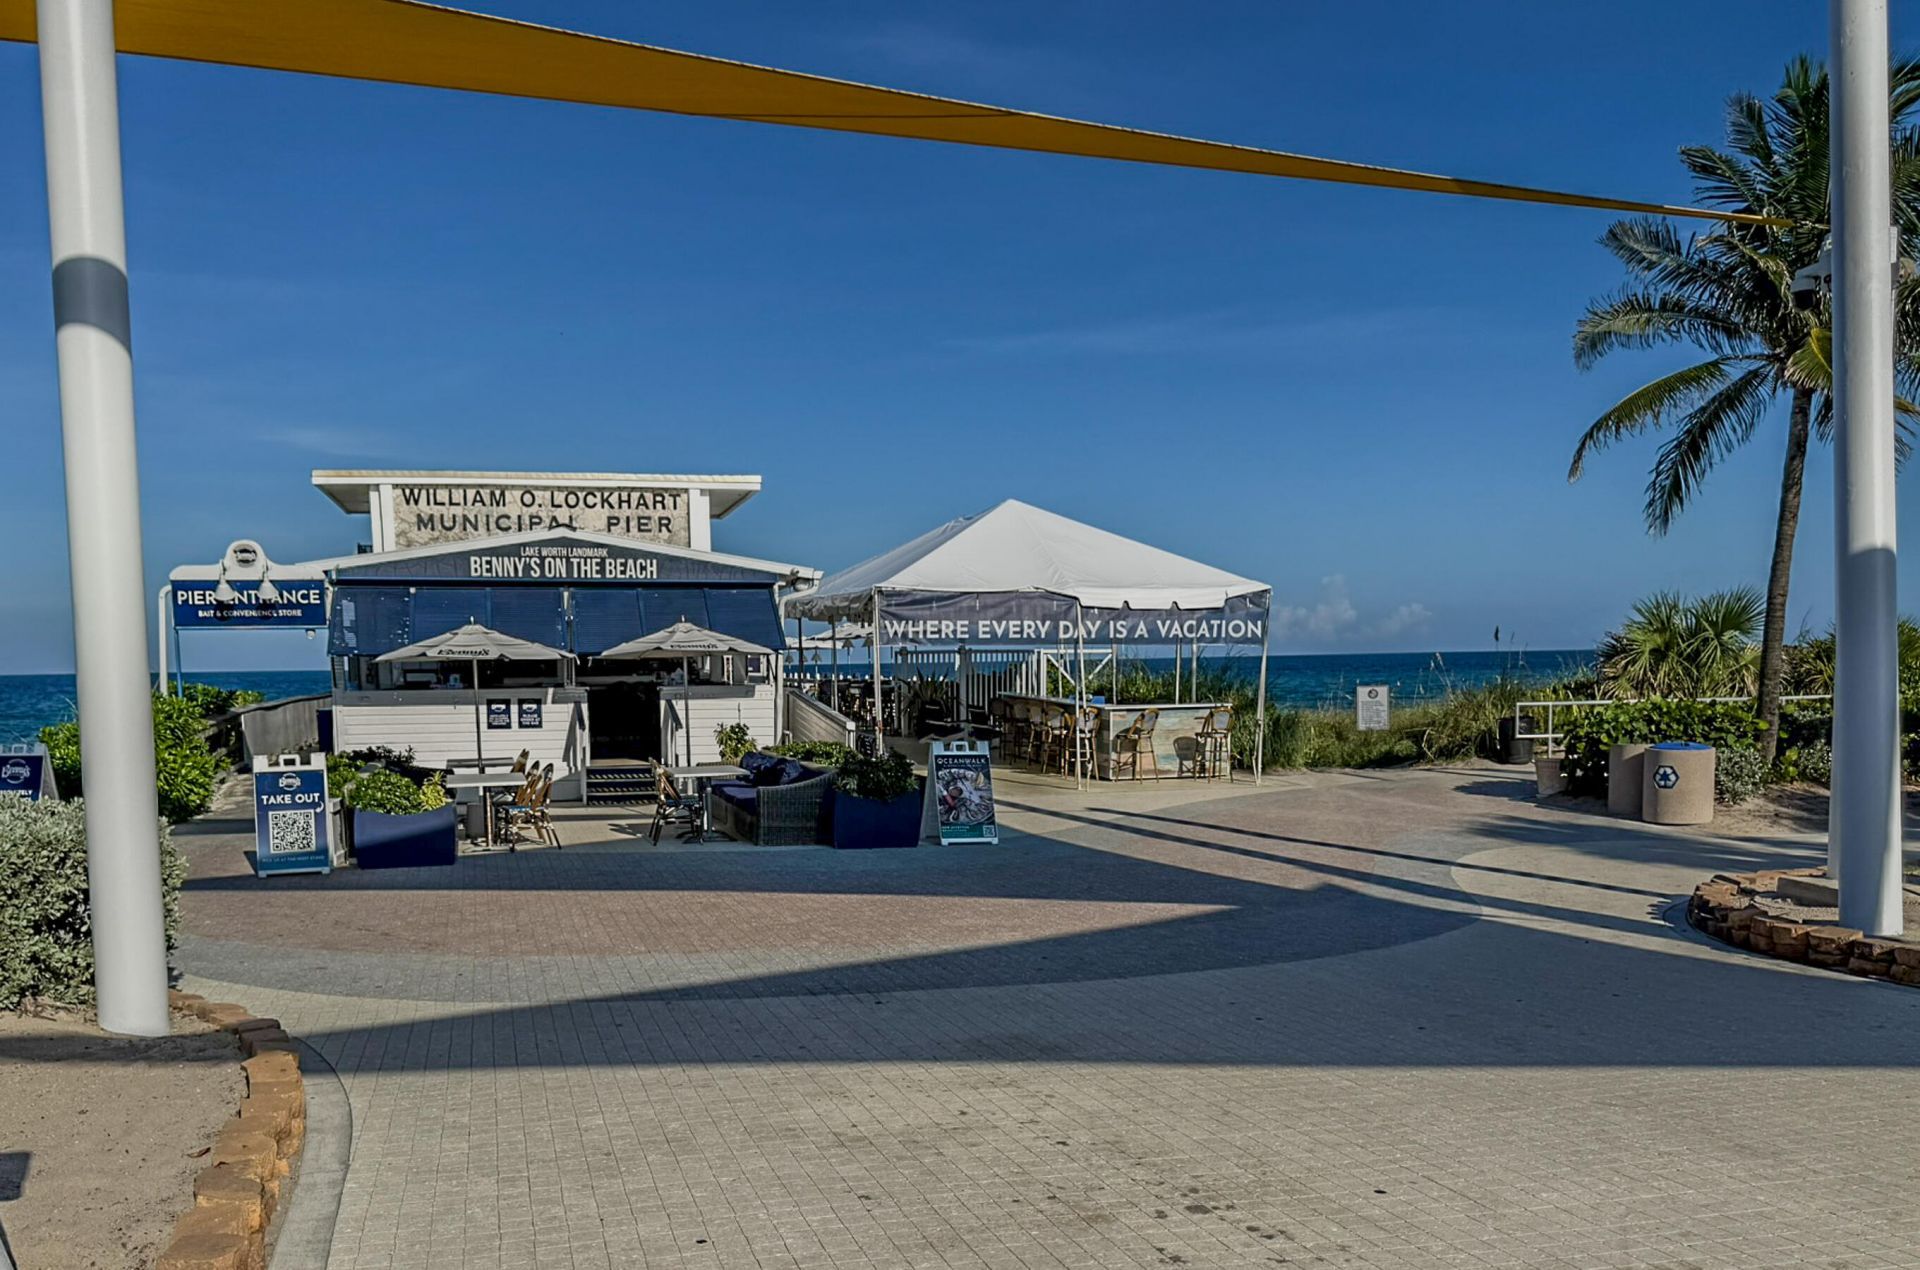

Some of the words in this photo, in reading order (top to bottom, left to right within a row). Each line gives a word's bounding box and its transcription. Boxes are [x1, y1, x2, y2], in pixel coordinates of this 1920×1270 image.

[401, 488, 506, 507] WILLIAM
[520, 490, 542, 507] O.
[550, 490, 681, 510] LOCKHART
[606, 516, 672, 533] PIER
[520, 547, 539, 556] LAKE
[541, 547, 567, 557] WORTH
[568, 548, 608, 558] LANDMARK
[470, 556, 540, 578] BENNY'S
[544, 557, 566, 578] ON
[570, 558, 601, 579] THE
[605, 558, 658, 579] BEACH
[177, 590, 217, 605] PIER
[198, 609, 214, 618] BAIT
[278, 609, 303, 618] STORE
[884, 620, 969, 639] WHERE
[978, 620, 1051, 639] EVERY
[1059, 620, 1101, 639] DAY
[1109, 620, 1127, 639] IS
[1134, 620, 1149, 639] A
[1156, 619, 1262, 639] VACATION
[261, 794, 292, 805] TAKE
[295, 793, 320, 803] OUT
